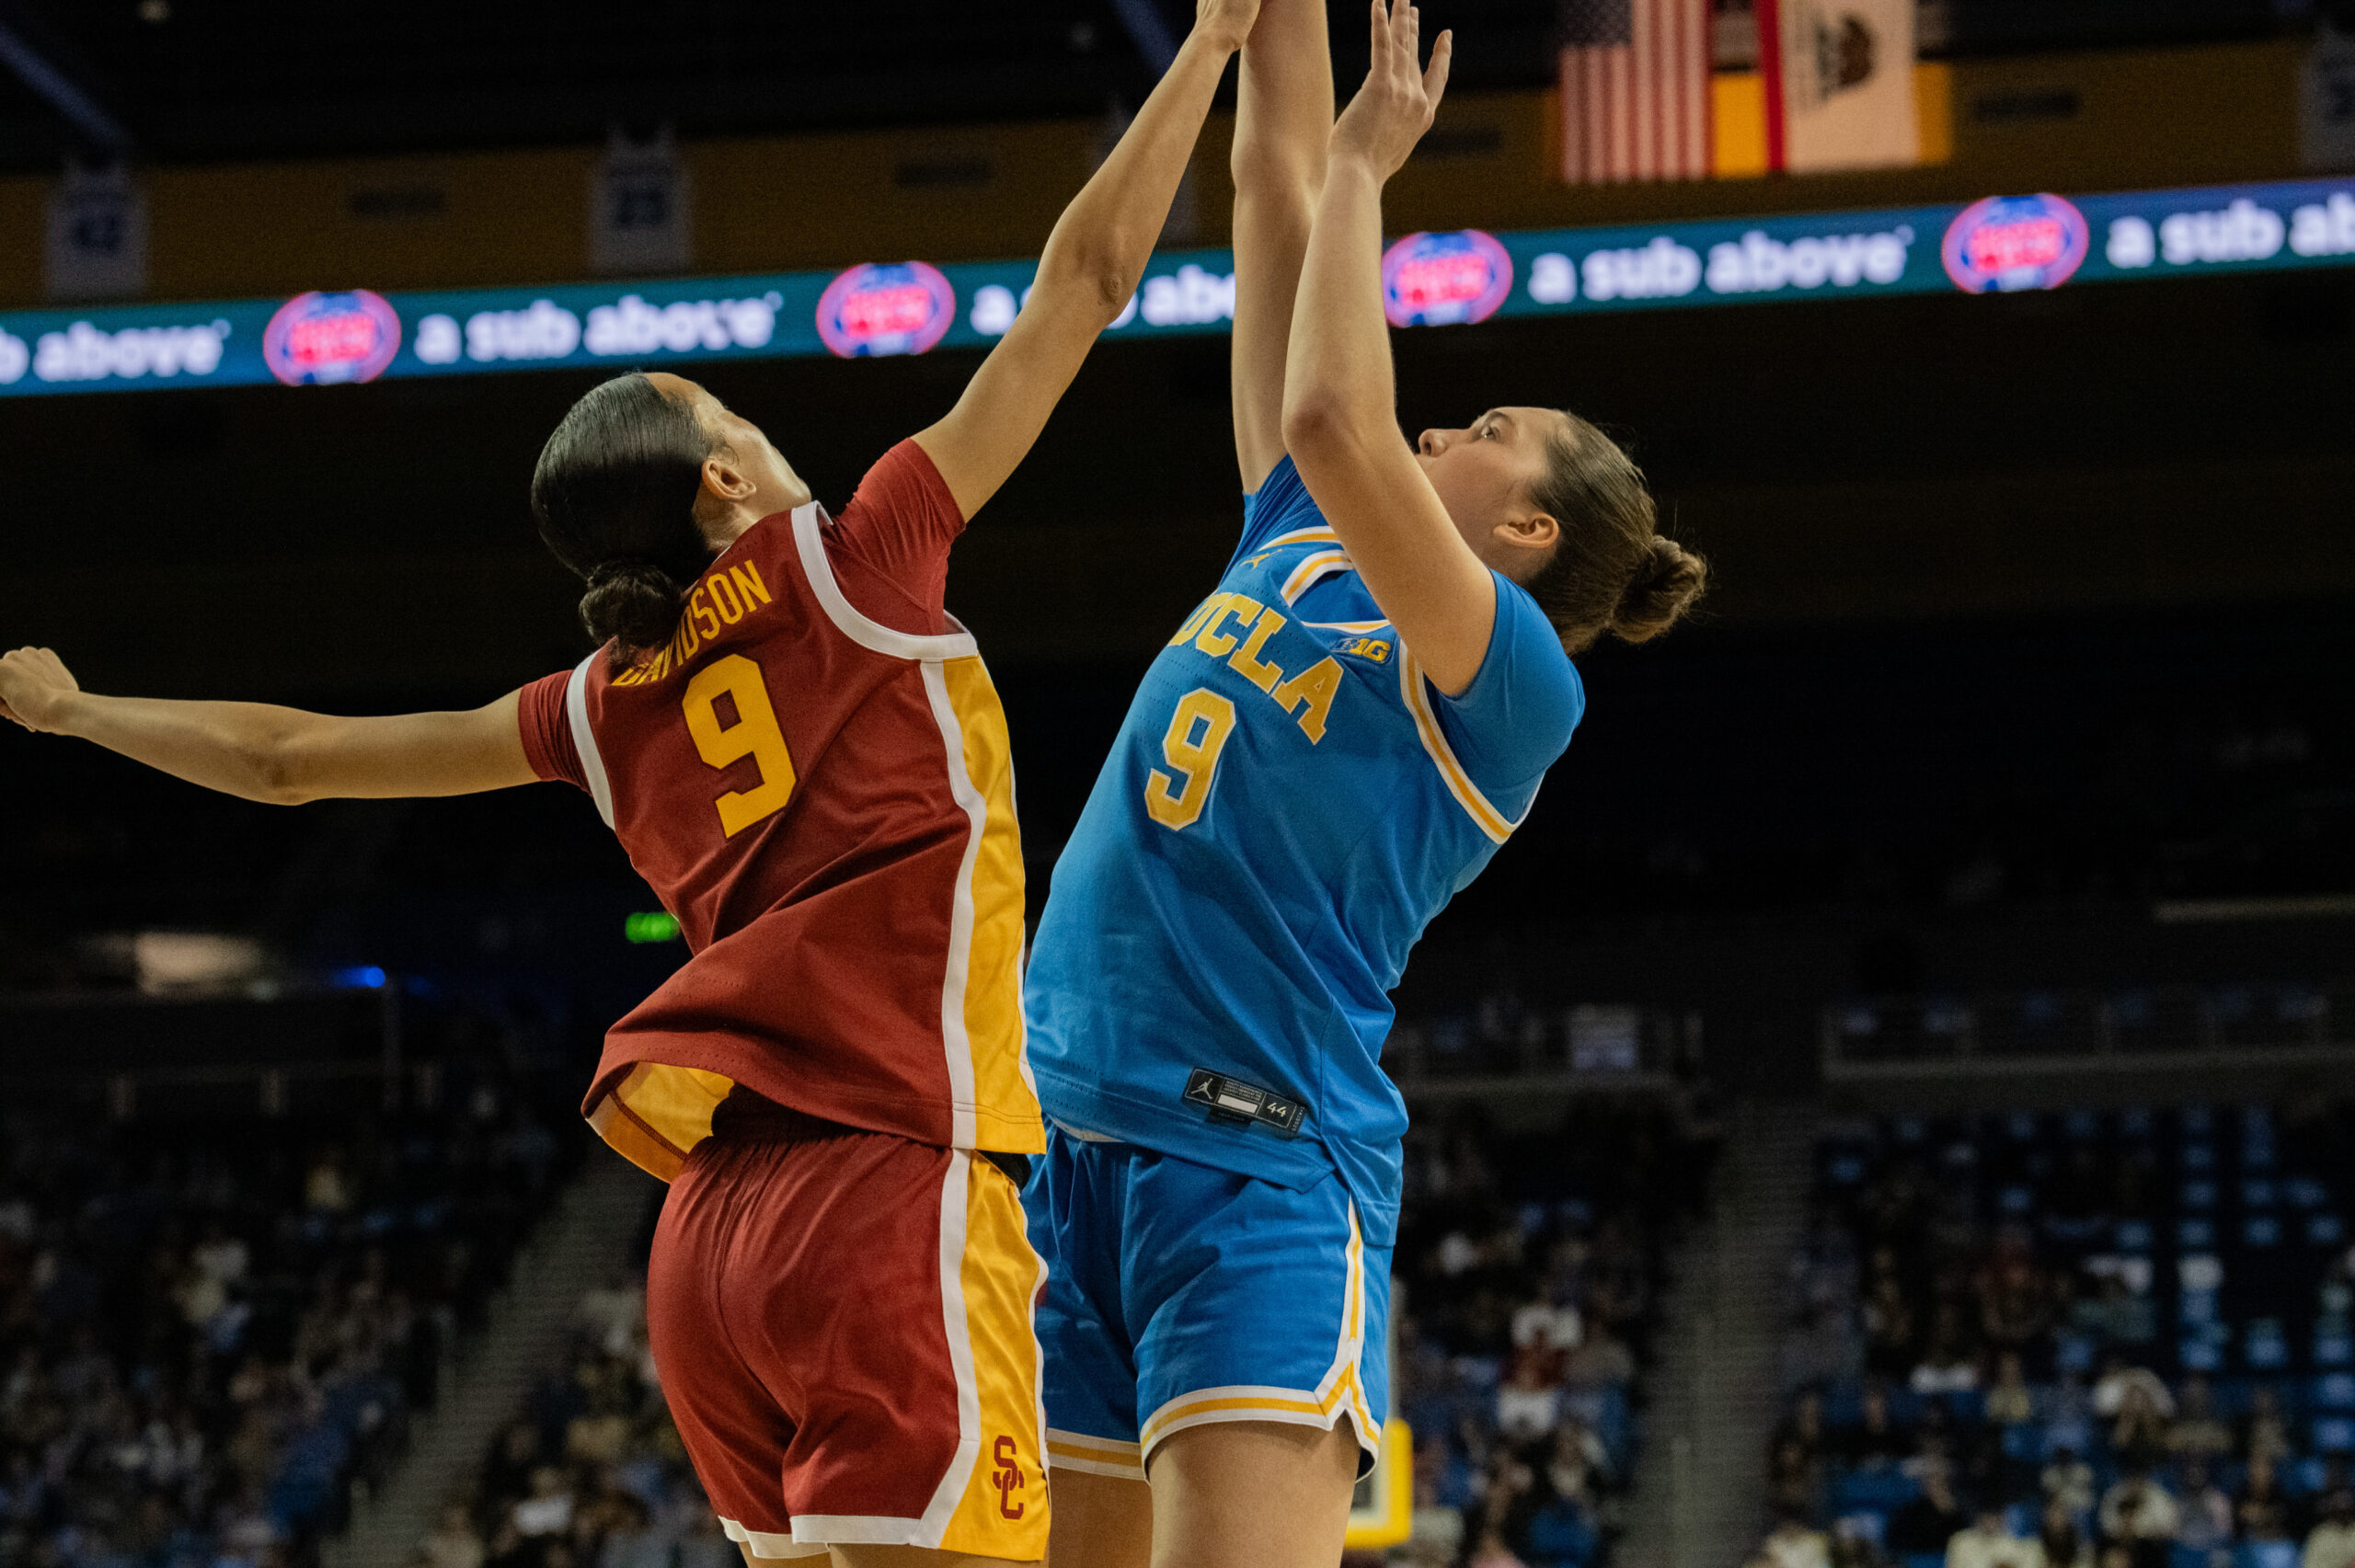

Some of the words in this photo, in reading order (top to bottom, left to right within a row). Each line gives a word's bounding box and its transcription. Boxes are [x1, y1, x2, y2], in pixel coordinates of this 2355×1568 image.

[2106, 215, 2154, 269] a
[2160, 198, 2285, 265] sub
[1528, 253, 1577, 304] a
[1581, 235, 1702, 301] sub
[414, 314, 461, 364] a
[465, 299, 581, 362] sub
[1167, 591, 1345, 746] UCLA
[682, 653, 798, 839] 9
[1144, 687, 1236, 831] 9
[1266, 1102, 1287, 1118] 44
